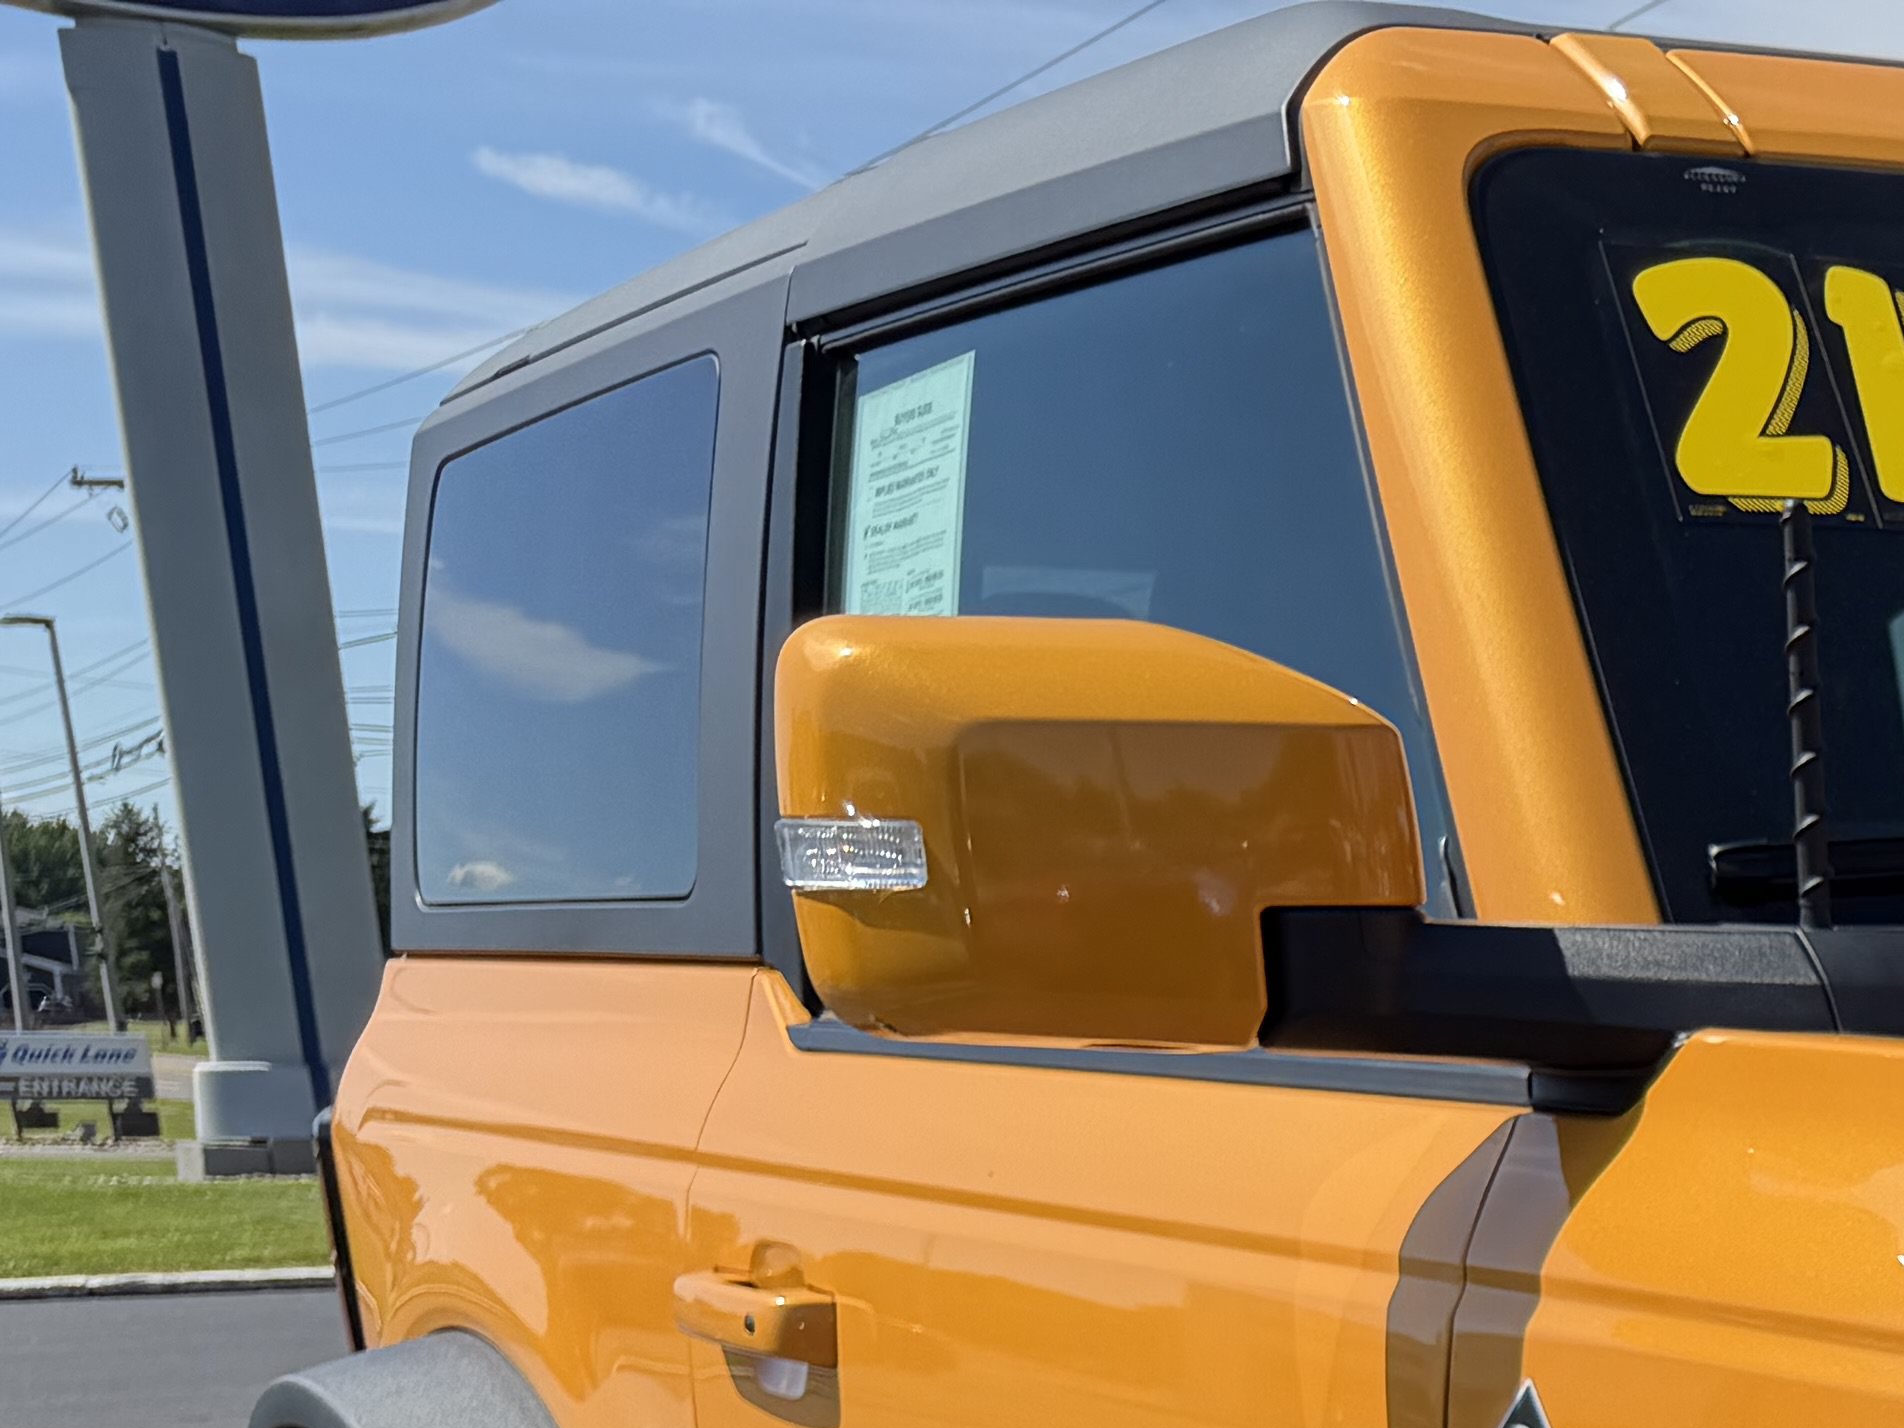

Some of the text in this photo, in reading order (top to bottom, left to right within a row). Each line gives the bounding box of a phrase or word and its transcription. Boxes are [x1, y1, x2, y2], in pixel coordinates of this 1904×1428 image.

[11, 1043, 137, 1065] Quick Lane
[18, 1076, 138, 1097] ENTRANCE
